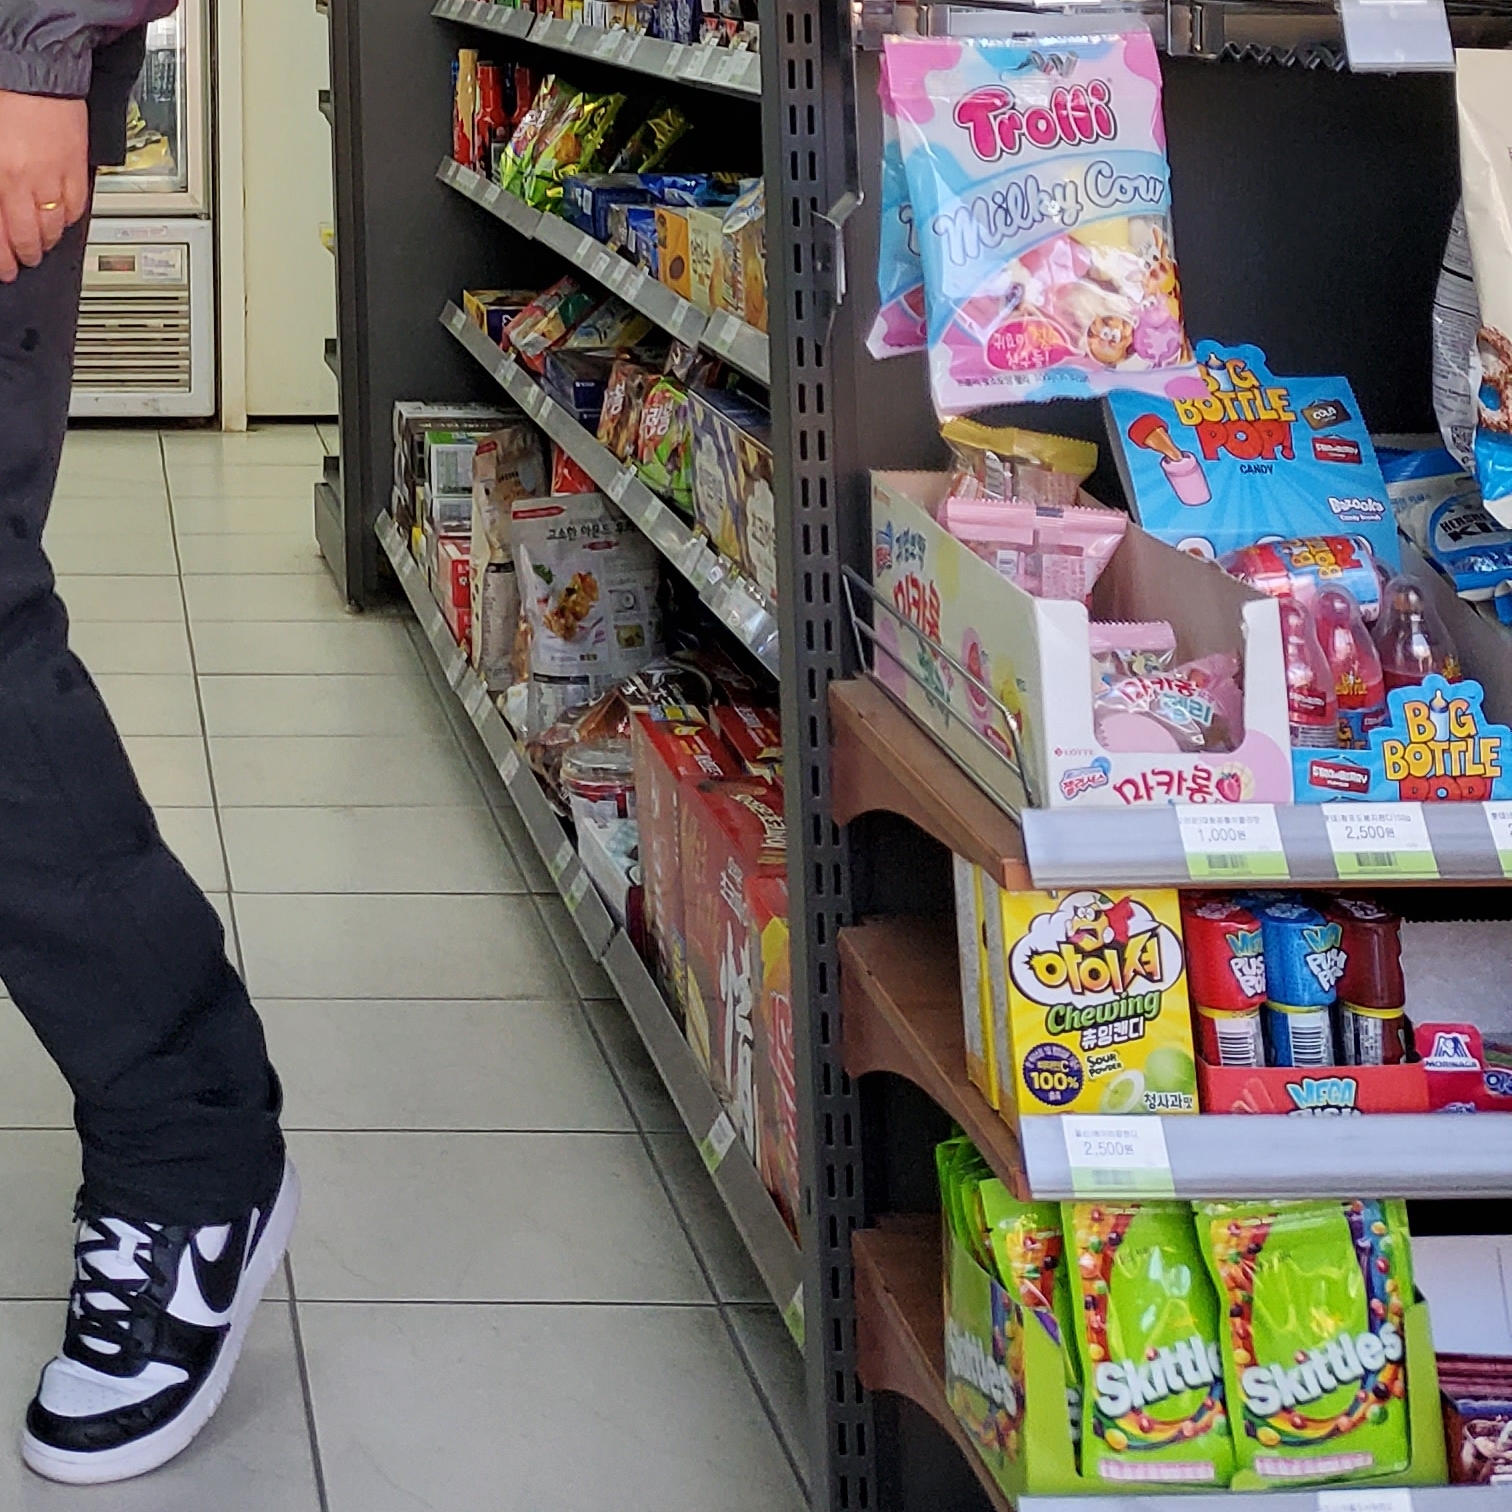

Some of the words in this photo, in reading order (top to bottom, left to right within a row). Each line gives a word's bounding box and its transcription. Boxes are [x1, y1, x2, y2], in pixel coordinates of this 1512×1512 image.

[956, 82, 1115, 161] Trolli
[933, 175, 1083, 266] Milky
[1085, 160, 1164, 208] Cow
[1173, 387, 1297, 426] BOTTLE
[1313, 407, 1336, 420] COLA
[1196, 420, 1296, 461] POP!
[1239, 464, 1273, 475] CANDY
[1403, 697, 1476, 744] BIG
[1064, 748, 1094, 756] LOTTE
[1383, 736, 1501, 780] BOTTLE
[1113, 765, 1214, 806] 마카롱
[1197, 828, 1246, 841] 1,000원
[1345, 825, 1395, 840] 2,500원
[1030, 925, 1164, 994] 아이셔
[1045, 990, 1161, 1035] Chewing
[1087, 1053, 1116, 1067] SOUR
[1088, 1064, 1123, 1078] POWDER
[1029, 1071, 1079, 1091] 100%
[1286, 1078, 1357, 1109] MEGA
[1144, 1092, 1193, 1111] 청사과맛
[1084, 1140, 1135, 1156] 2,500원
[1241, 1322, 1404, 1416] Skittles
